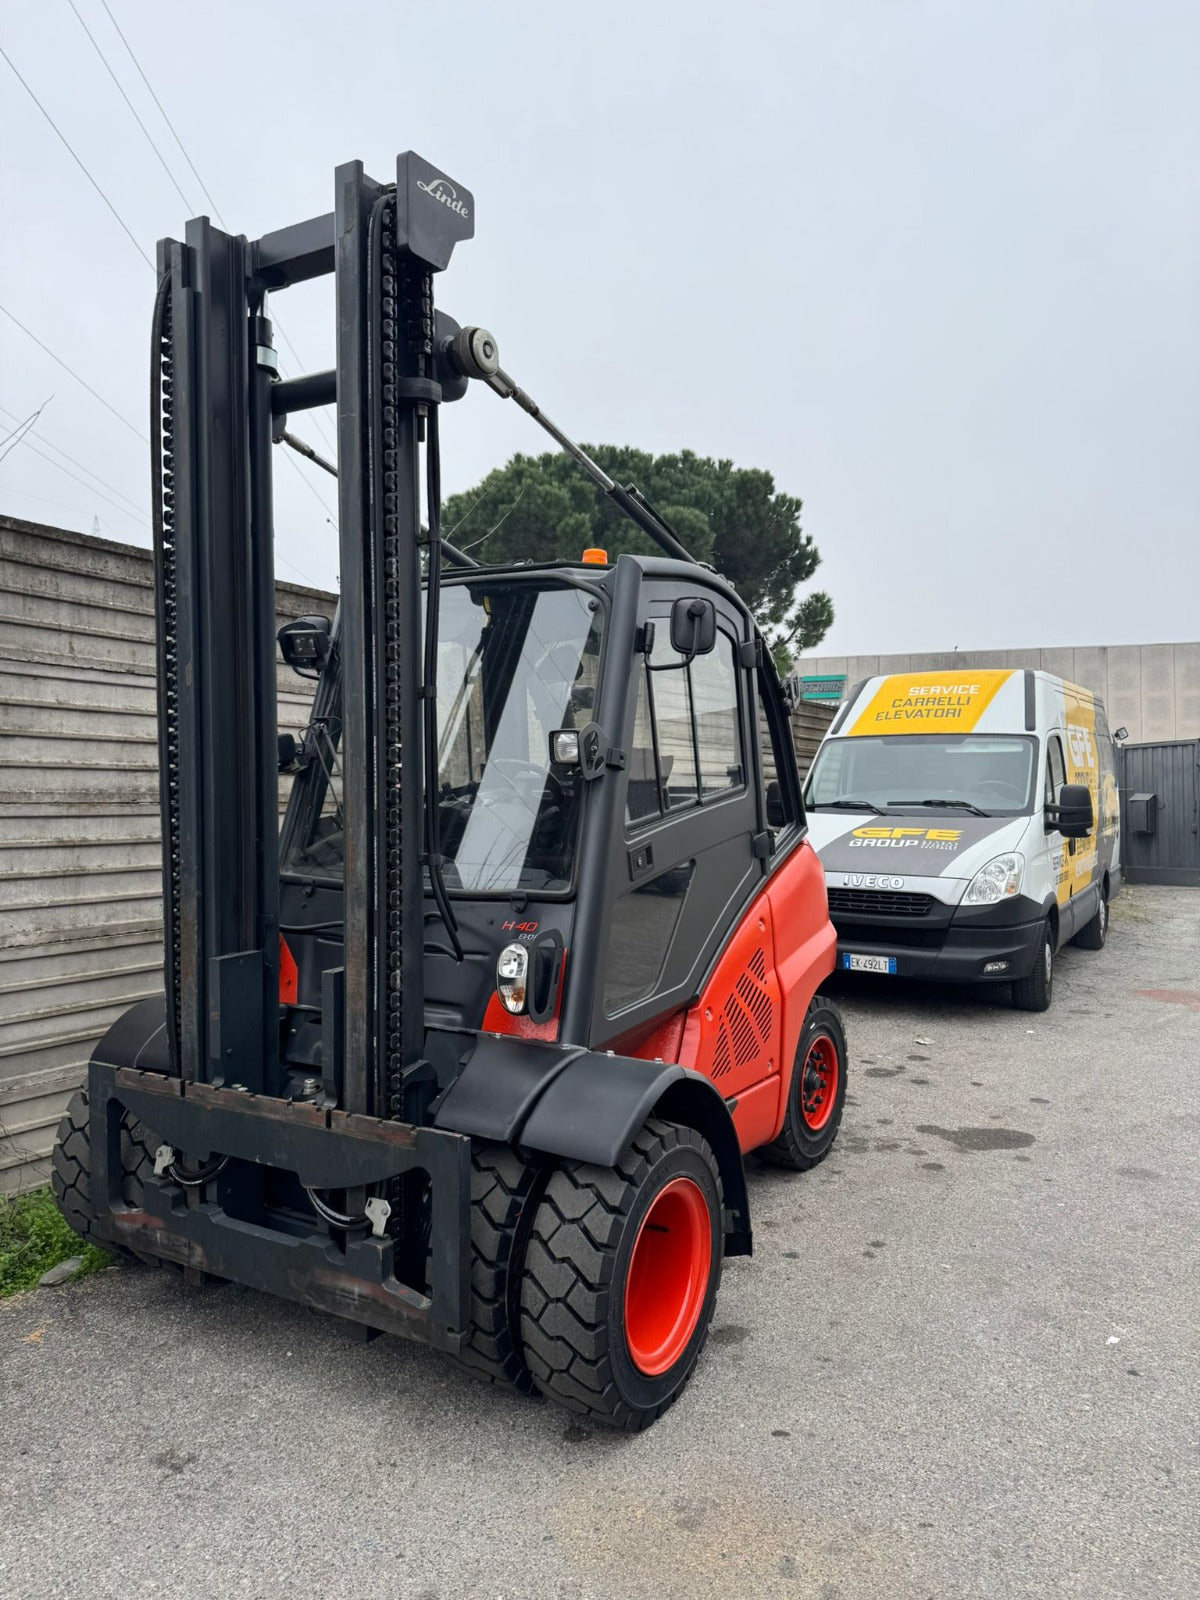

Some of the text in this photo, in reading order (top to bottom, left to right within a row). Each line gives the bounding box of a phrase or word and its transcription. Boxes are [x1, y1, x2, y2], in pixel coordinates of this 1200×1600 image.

[416, 179, 469, 219] Linde
[908, 684, 980, 696] SERVICE
[891, 696, 971, 708] CARRELLI
[875, 708, 962, 722] ELEVATORI
[1067, 723, 1095, 769] GFE
[851, 827, 965, 841] GFE
[848, 838, 920, 848] GROUP
[843, 873, 905, 889] IVECO
